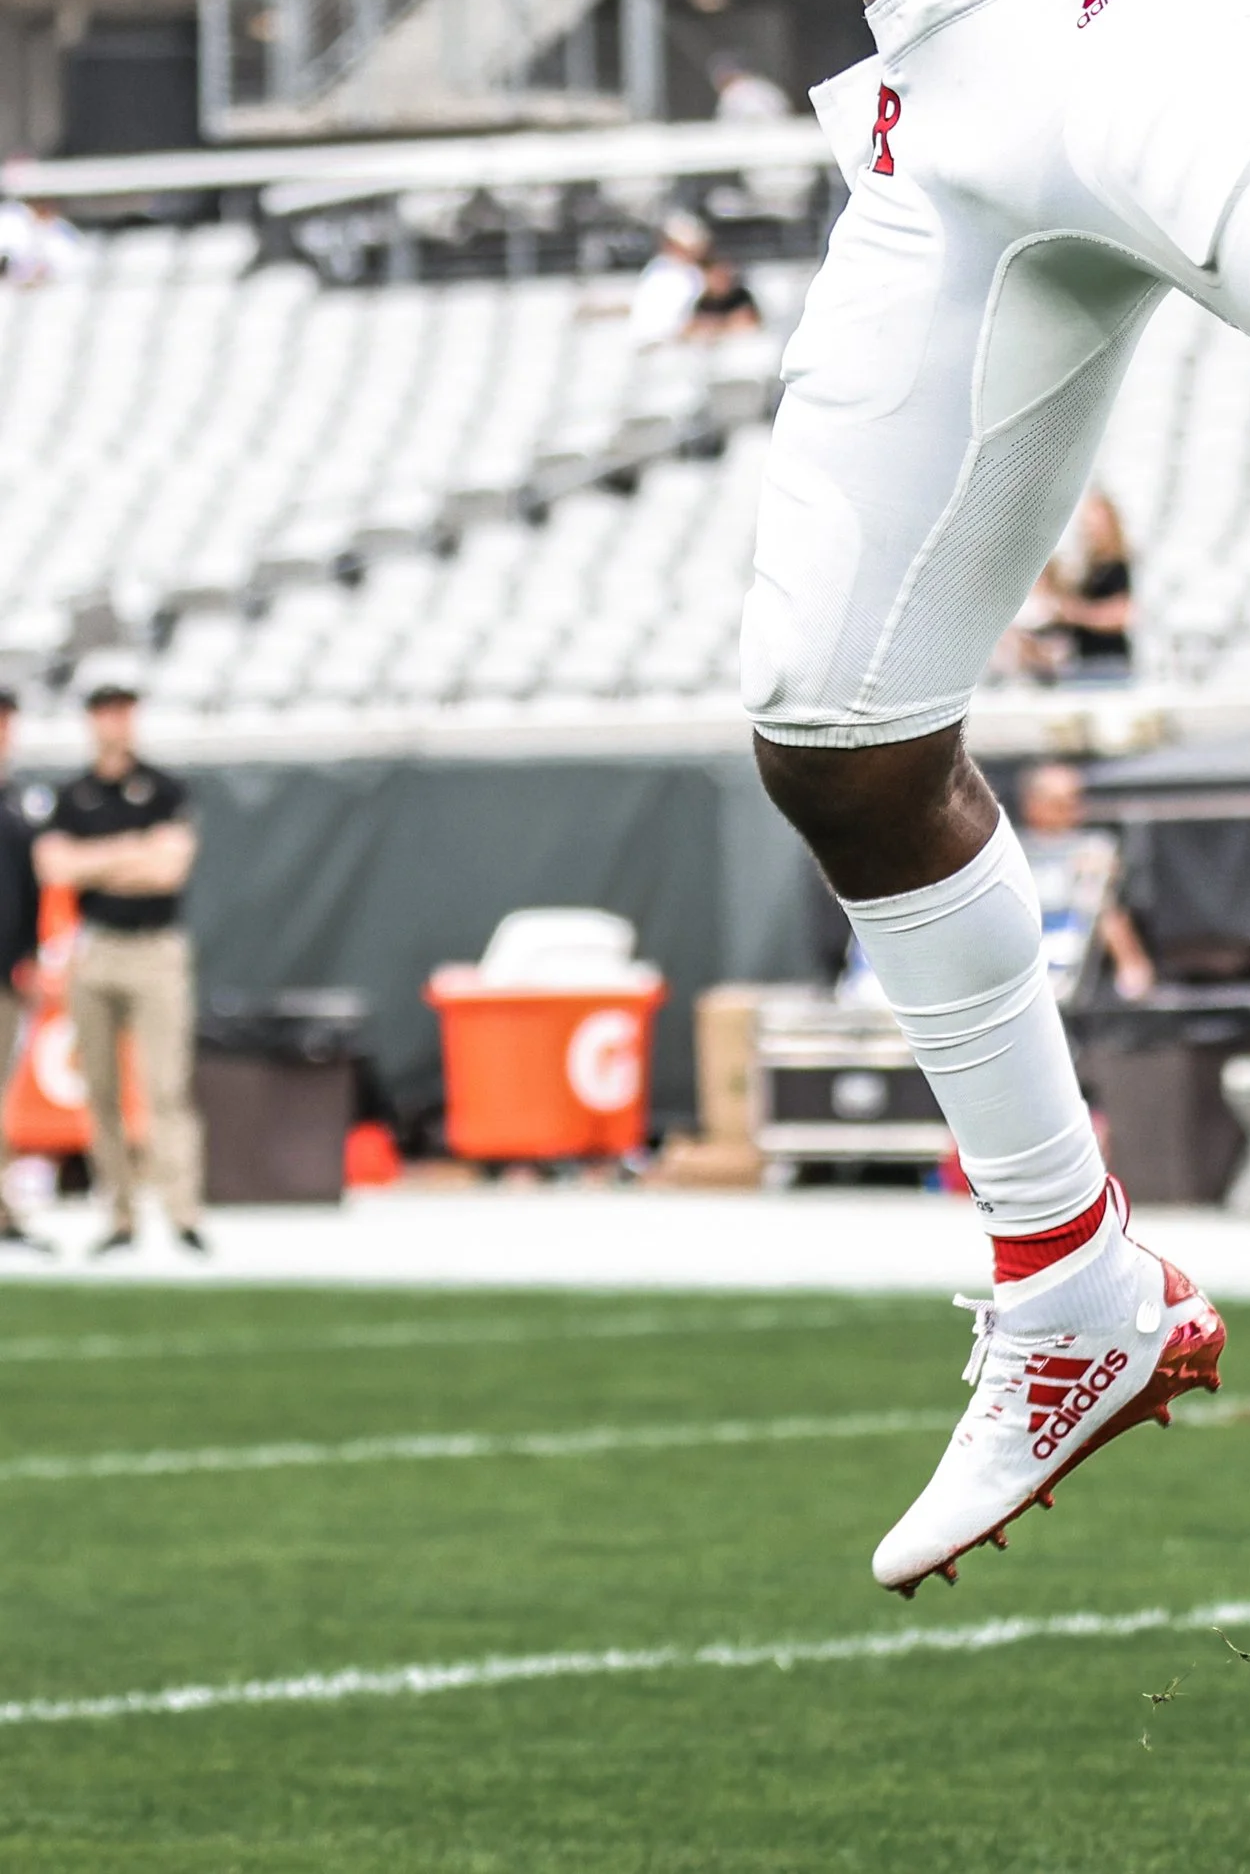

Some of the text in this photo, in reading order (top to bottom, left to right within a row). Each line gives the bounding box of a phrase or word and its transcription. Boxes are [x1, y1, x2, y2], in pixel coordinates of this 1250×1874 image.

[868, 81, 902, 176] R
[564, 1006, 643, 1114] G
[1032, 1348, 1129, 1461] adidas
